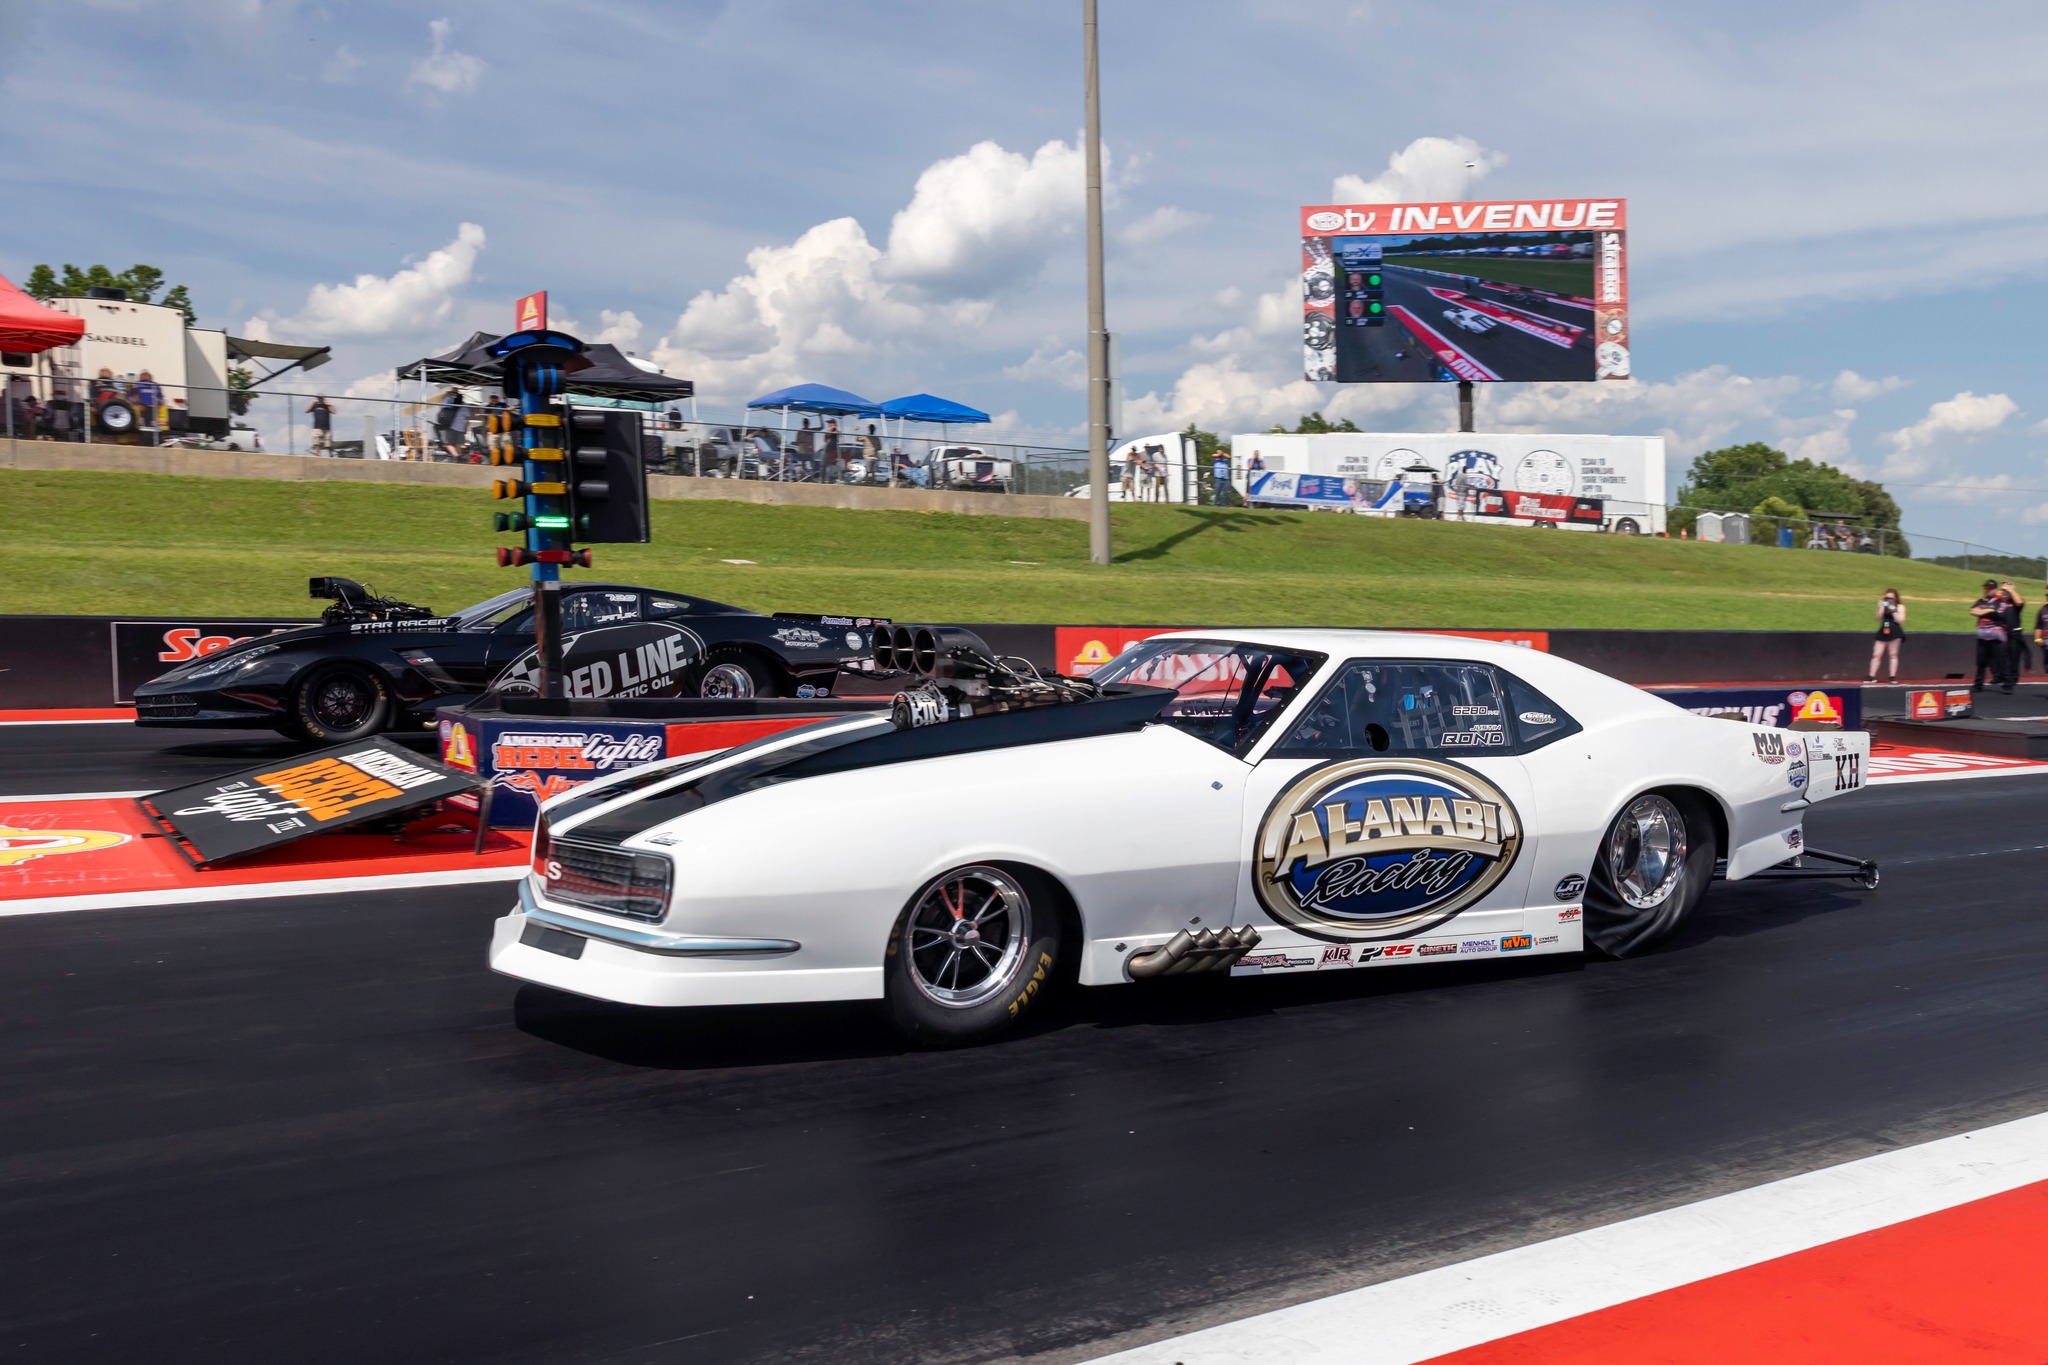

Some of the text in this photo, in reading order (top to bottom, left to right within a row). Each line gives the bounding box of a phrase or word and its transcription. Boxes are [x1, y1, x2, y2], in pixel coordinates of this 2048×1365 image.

[1389, 202, 1619, 230] IN-VENUE
[85, 332, 147, 347] SANIBEL
[350, 618, 449, 631] STAR RACER
[821, 616, 853, 626] Permatex
[785, 640, 819, 648] MOTORSPORTS
[618, 634, 688, 688] LINE
[651, 675, 674, 690] OIL
[1453, 706, 1488, 715] 6280
[501, 735, 584, 747] AMERICAN
[1440, 732, 1505, 746] BOND
[496, 734, 660, 769] REBEL light
[1759, 755, 1786, 765] TRANSMISSION
[337, 749, 448, 789] AMERICAN
[1835, 753, 1859, 791] KH
[252, 757, 405, 822] REBEL
[1273, 796, 1502, 880] AL-ANABI
[1300, 848, 1473, 908] Racing
[1420, 944, 1457, 952] KINETIC
[1502, 936, 1530, 949] MVM
[1288, 958, 1314, 966] PRODUCTS
[1009, 951, 1052, 1018] EAGLE
